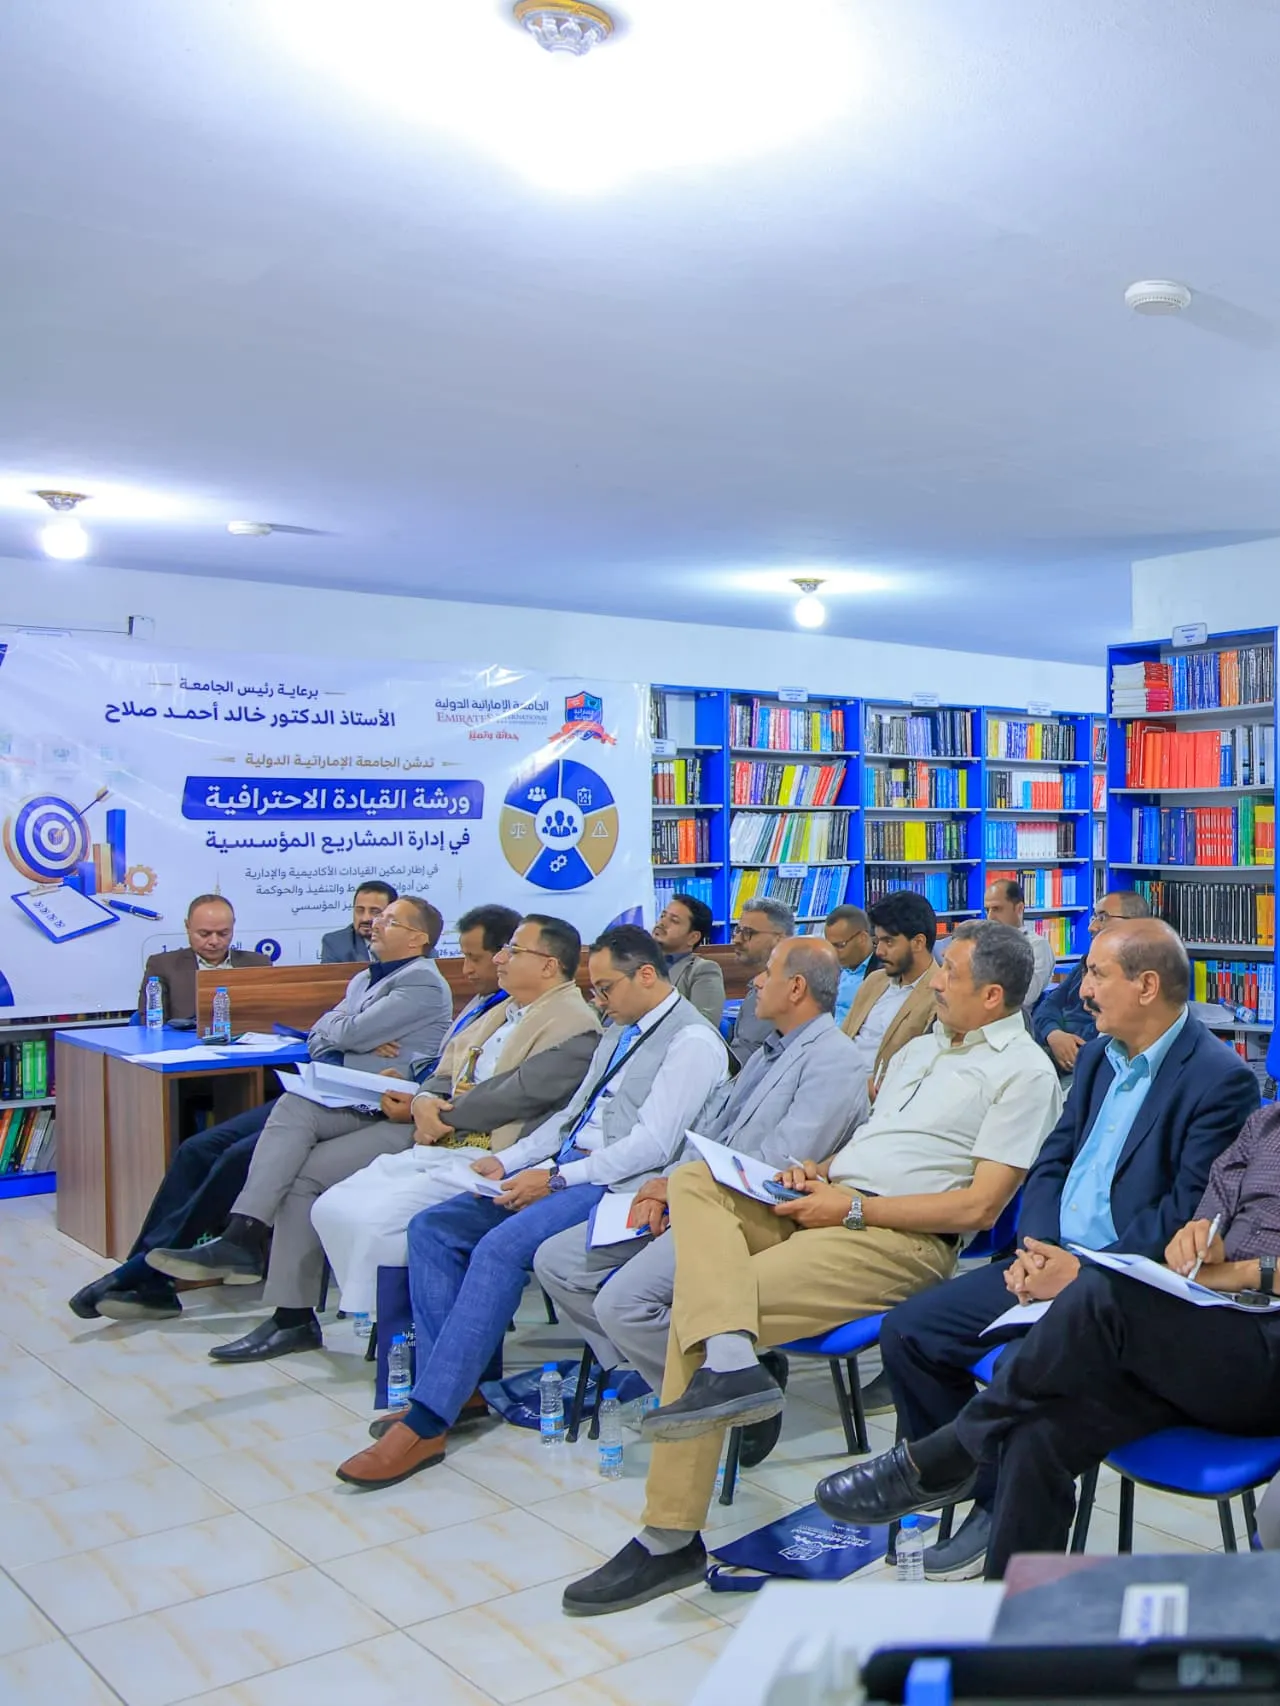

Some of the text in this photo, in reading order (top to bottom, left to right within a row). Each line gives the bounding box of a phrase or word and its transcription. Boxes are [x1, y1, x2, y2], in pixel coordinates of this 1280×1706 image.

[179, 677, 319, 700] برعاية رئيس الجامعة
[435, 697, 470, 711] الدولية
[512, 699, 549, 712] الجامة
[105, 701, 396, 728] الأستاذ الدكتور خالد أحمد صلاح
[245, 753, 290, 768] الدولية
[355, 755, 400, 770] الجامعة
[402, 756, 435, 770] تدشن
[205, 783, 470, 816] ورشة القيادة الاحترافية
[206, 828, 470, 855] في إدارة المشاريع المؤسسية
